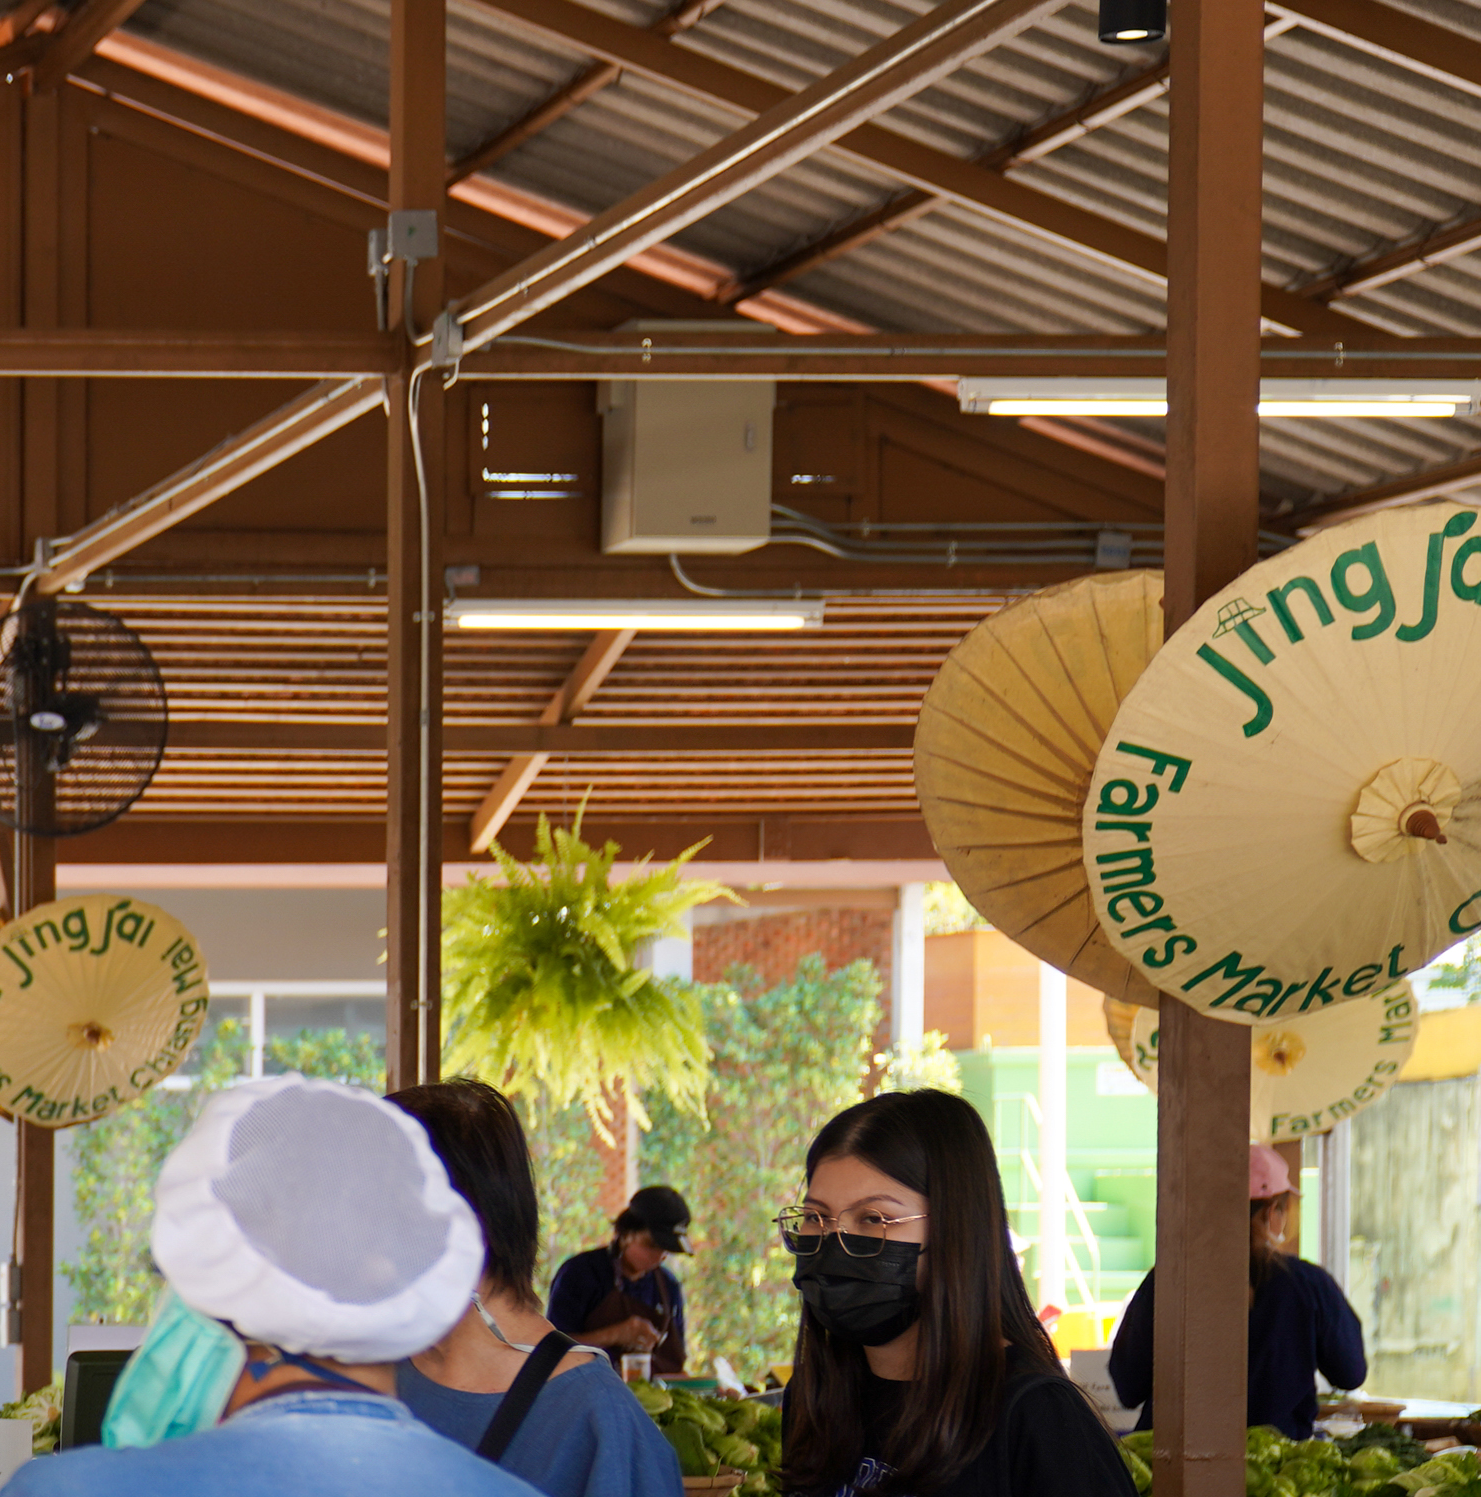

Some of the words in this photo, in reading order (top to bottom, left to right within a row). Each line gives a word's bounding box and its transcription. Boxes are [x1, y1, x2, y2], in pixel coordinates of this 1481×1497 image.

[1095, 740, 1198, 969] Farmers
[1181, 944, 1408, 1018] Market
[10, 1085, 120, 1121] Market
[1272, 1060, 1398, 1135] Farmers
